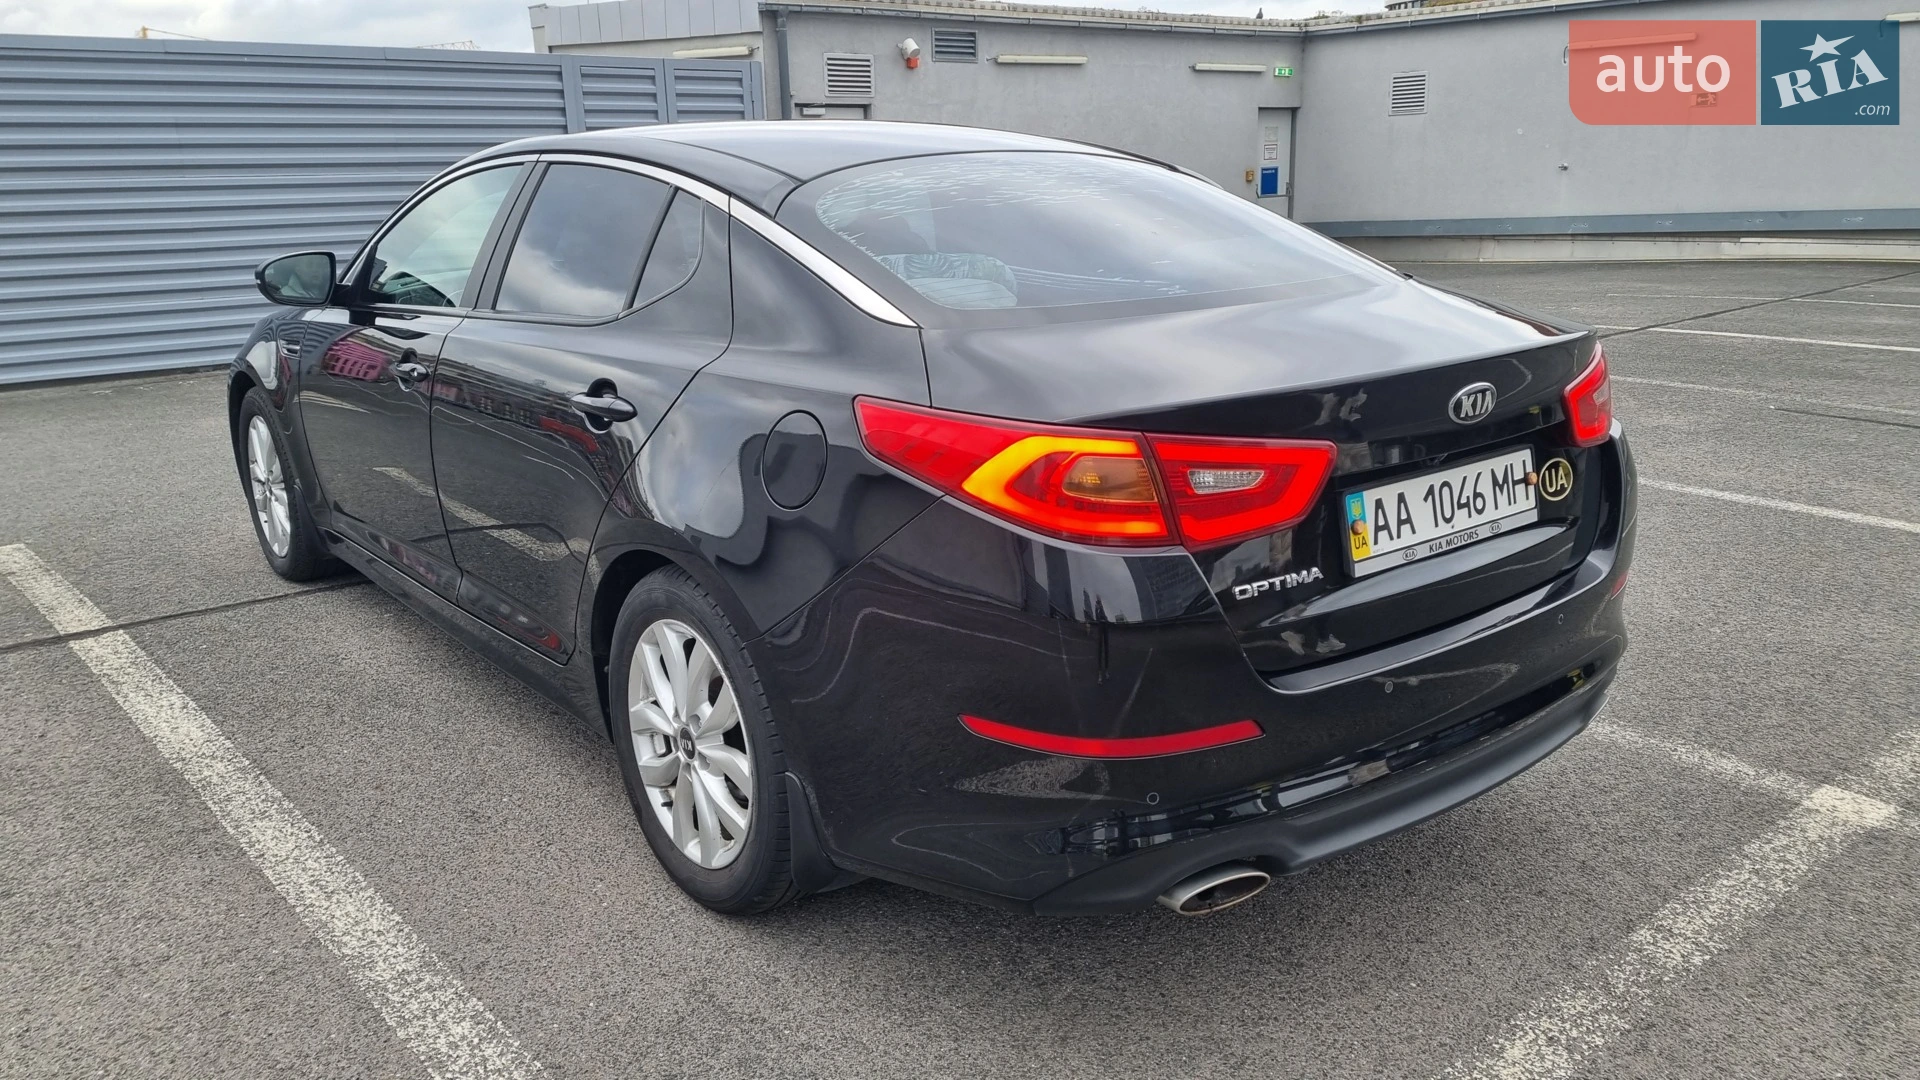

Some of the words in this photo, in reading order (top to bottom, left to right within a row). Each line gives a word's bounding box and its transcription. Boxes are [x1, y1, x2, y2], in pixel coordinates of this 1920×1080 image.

[1459, 390, 1494, 418] KIA
[1545, 466, 1568, 493] UA
[1373, 491, 1417, 546] AA
[1422, 471, 1487, 528] 1046
[1490, 458, 1530, 511] MH
[1353, 535, 1368, 550] UA
[1403, 549, 1416, 560] KIA
[1428, 543, 1444, 553] KIA
[1445, 529, 1479, 549] MOTORS
[1231, 566, 1324, 601] OPTIMA
